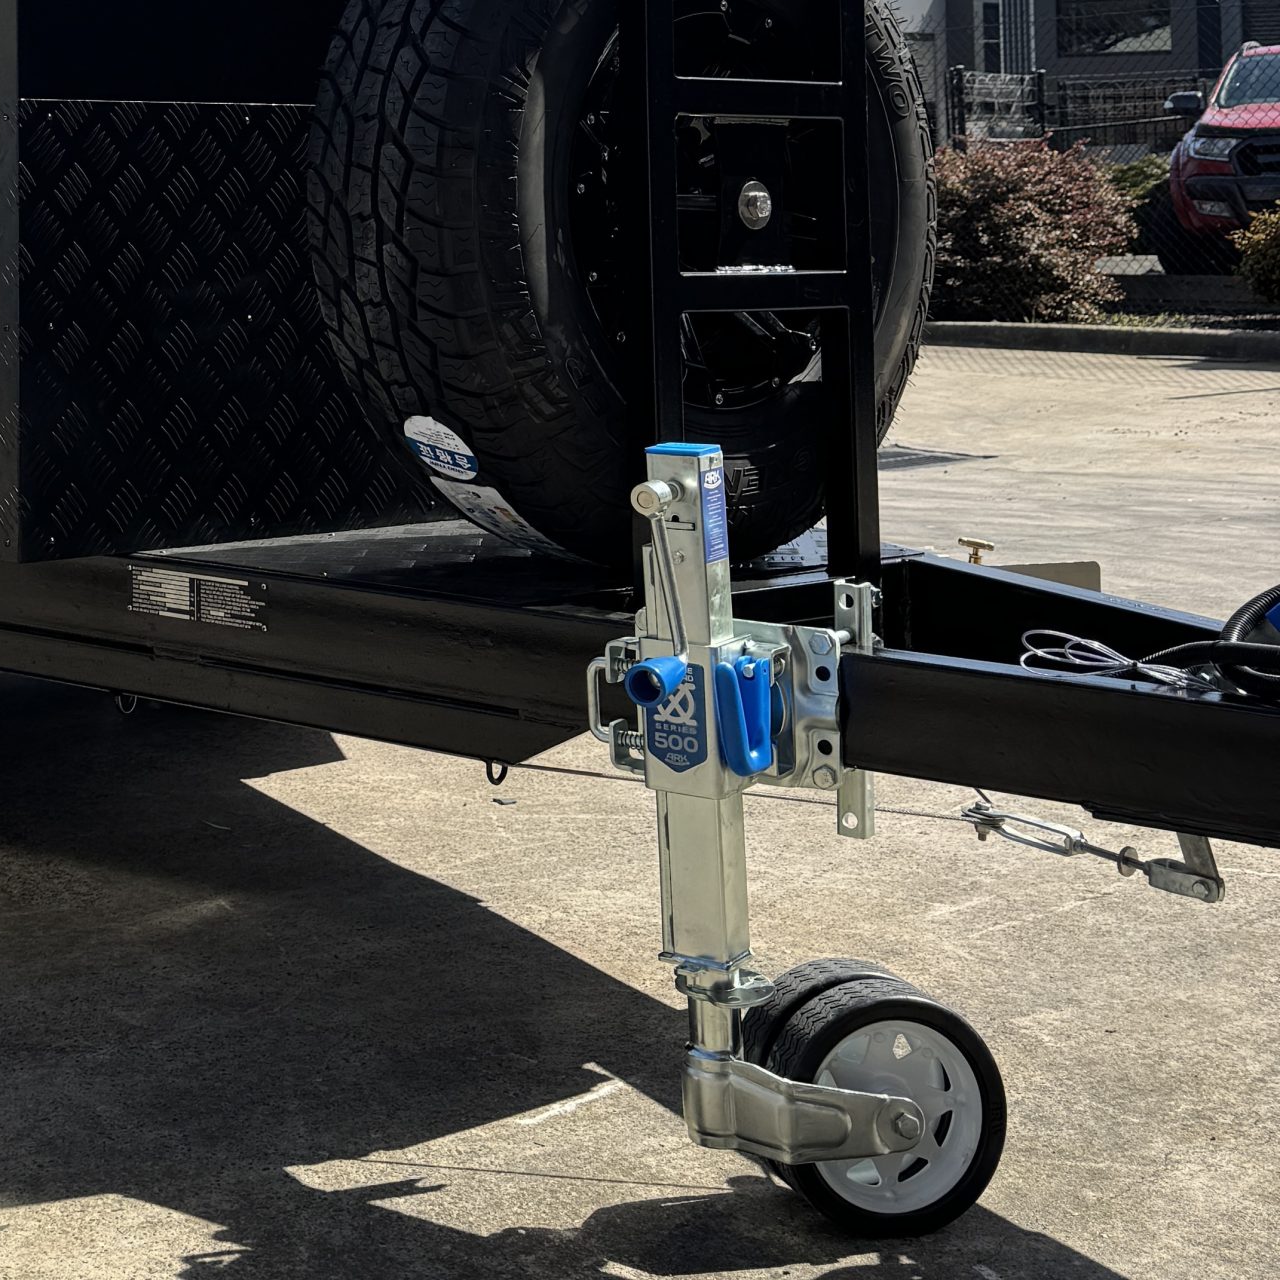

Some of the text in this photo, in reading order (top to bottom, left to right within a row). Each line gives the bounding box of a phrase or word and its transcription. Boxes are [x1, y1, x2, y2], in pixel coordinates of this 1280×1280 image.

[865, 13, 912, 118] TWO
[704, 469, 721, 485] ARK
[655, 722, 698, 735] SERIES
[654, 731, 699, 753] 500
[666, 752, 688, 763] ARK
